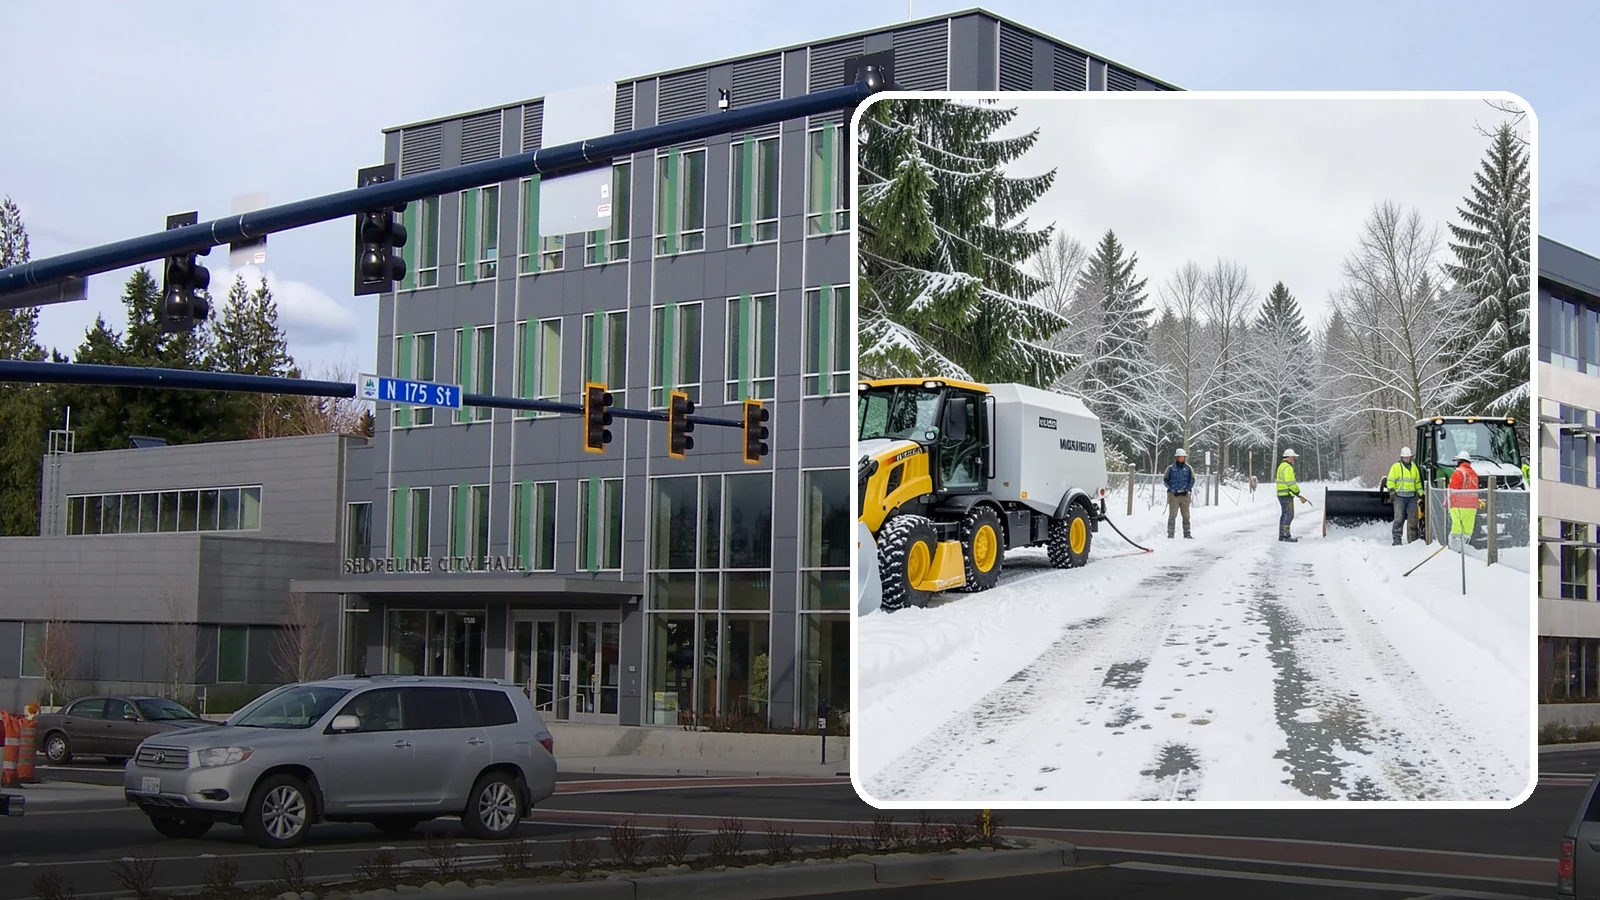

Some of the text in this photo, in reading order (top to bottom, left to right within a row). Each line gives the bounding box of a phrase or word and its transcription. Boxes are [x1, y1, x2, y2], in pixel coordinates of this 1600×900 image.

[387, 380, 451, 406] N 175 St
[344, 555, 526, 574] SHORELINE CITY HALL
